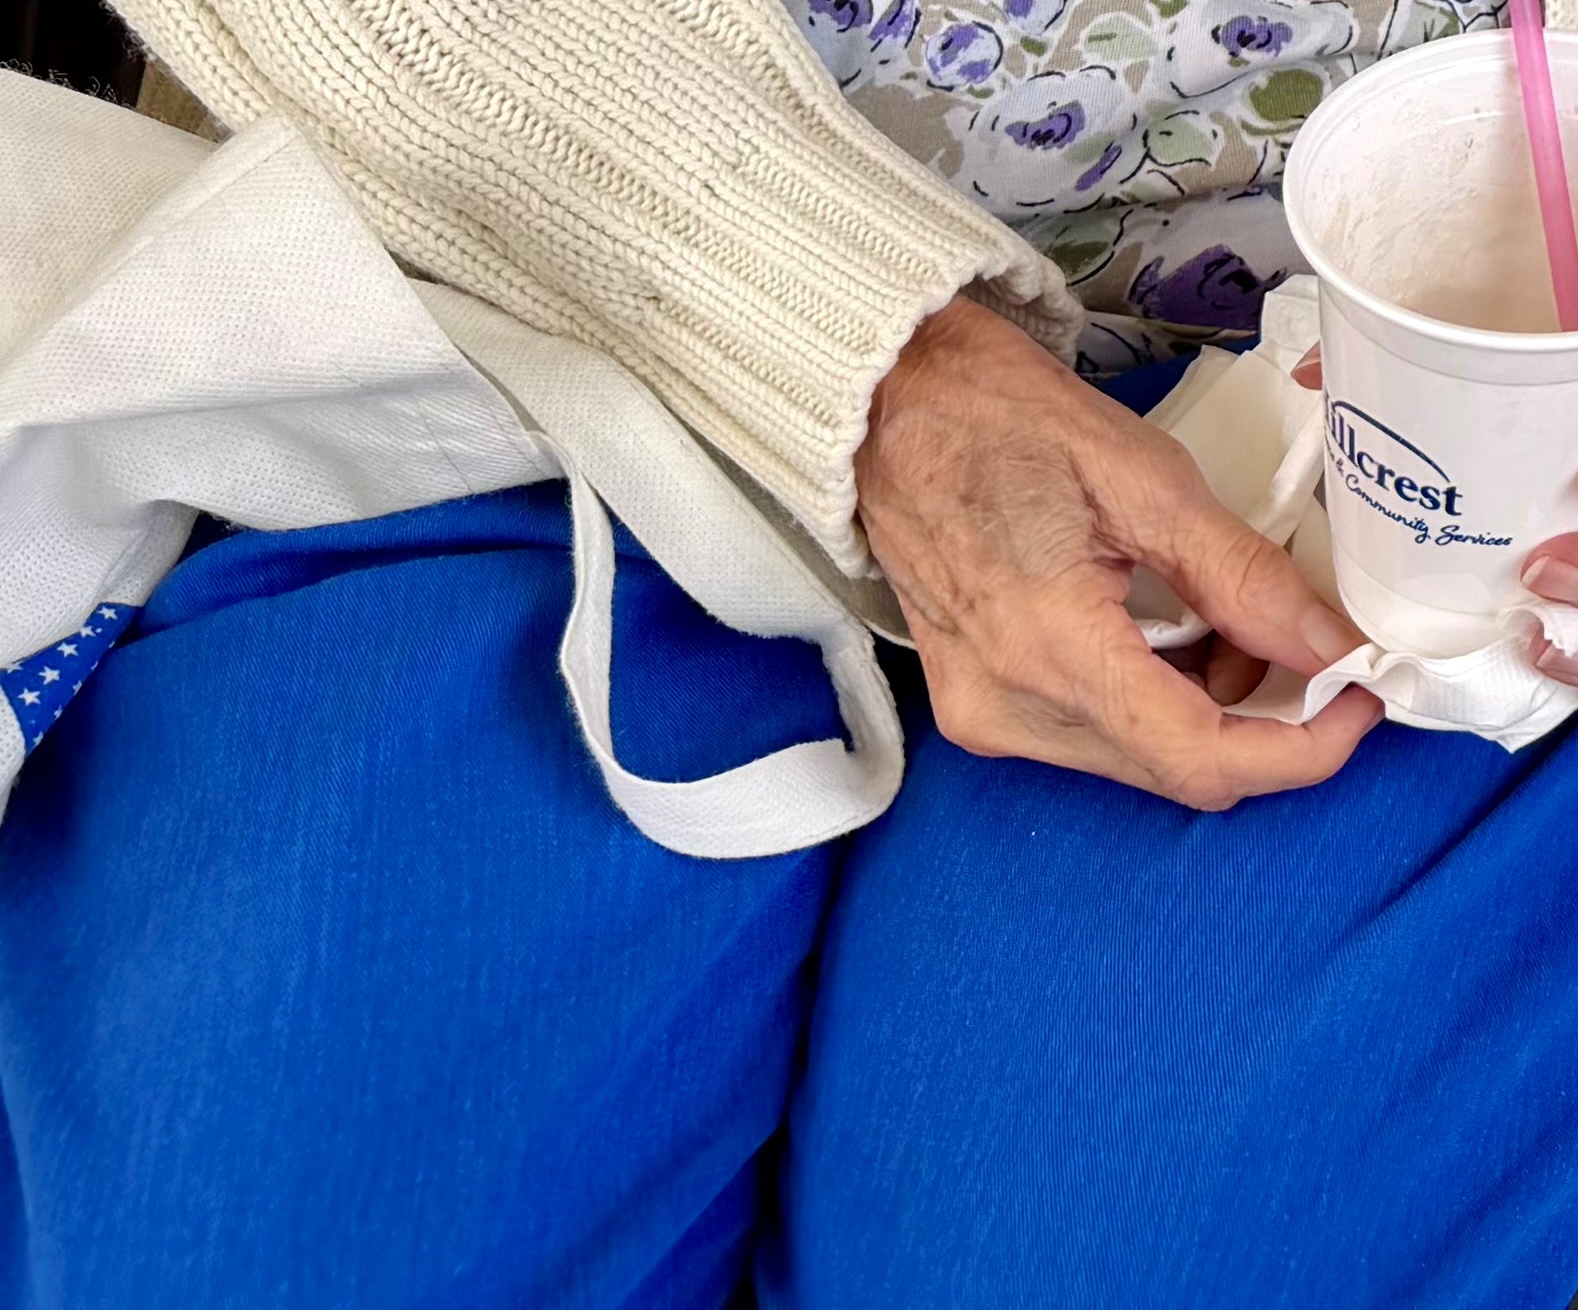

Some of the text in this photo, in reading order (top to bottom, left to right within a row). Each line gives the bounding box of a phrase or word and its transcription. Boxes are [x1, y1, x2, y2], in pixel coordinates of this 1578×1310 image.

[1325, 390, 1464, 517] illcrest
[1345, 473, 1431, 545] Community
[1434, 524, 1514, 547] Services
